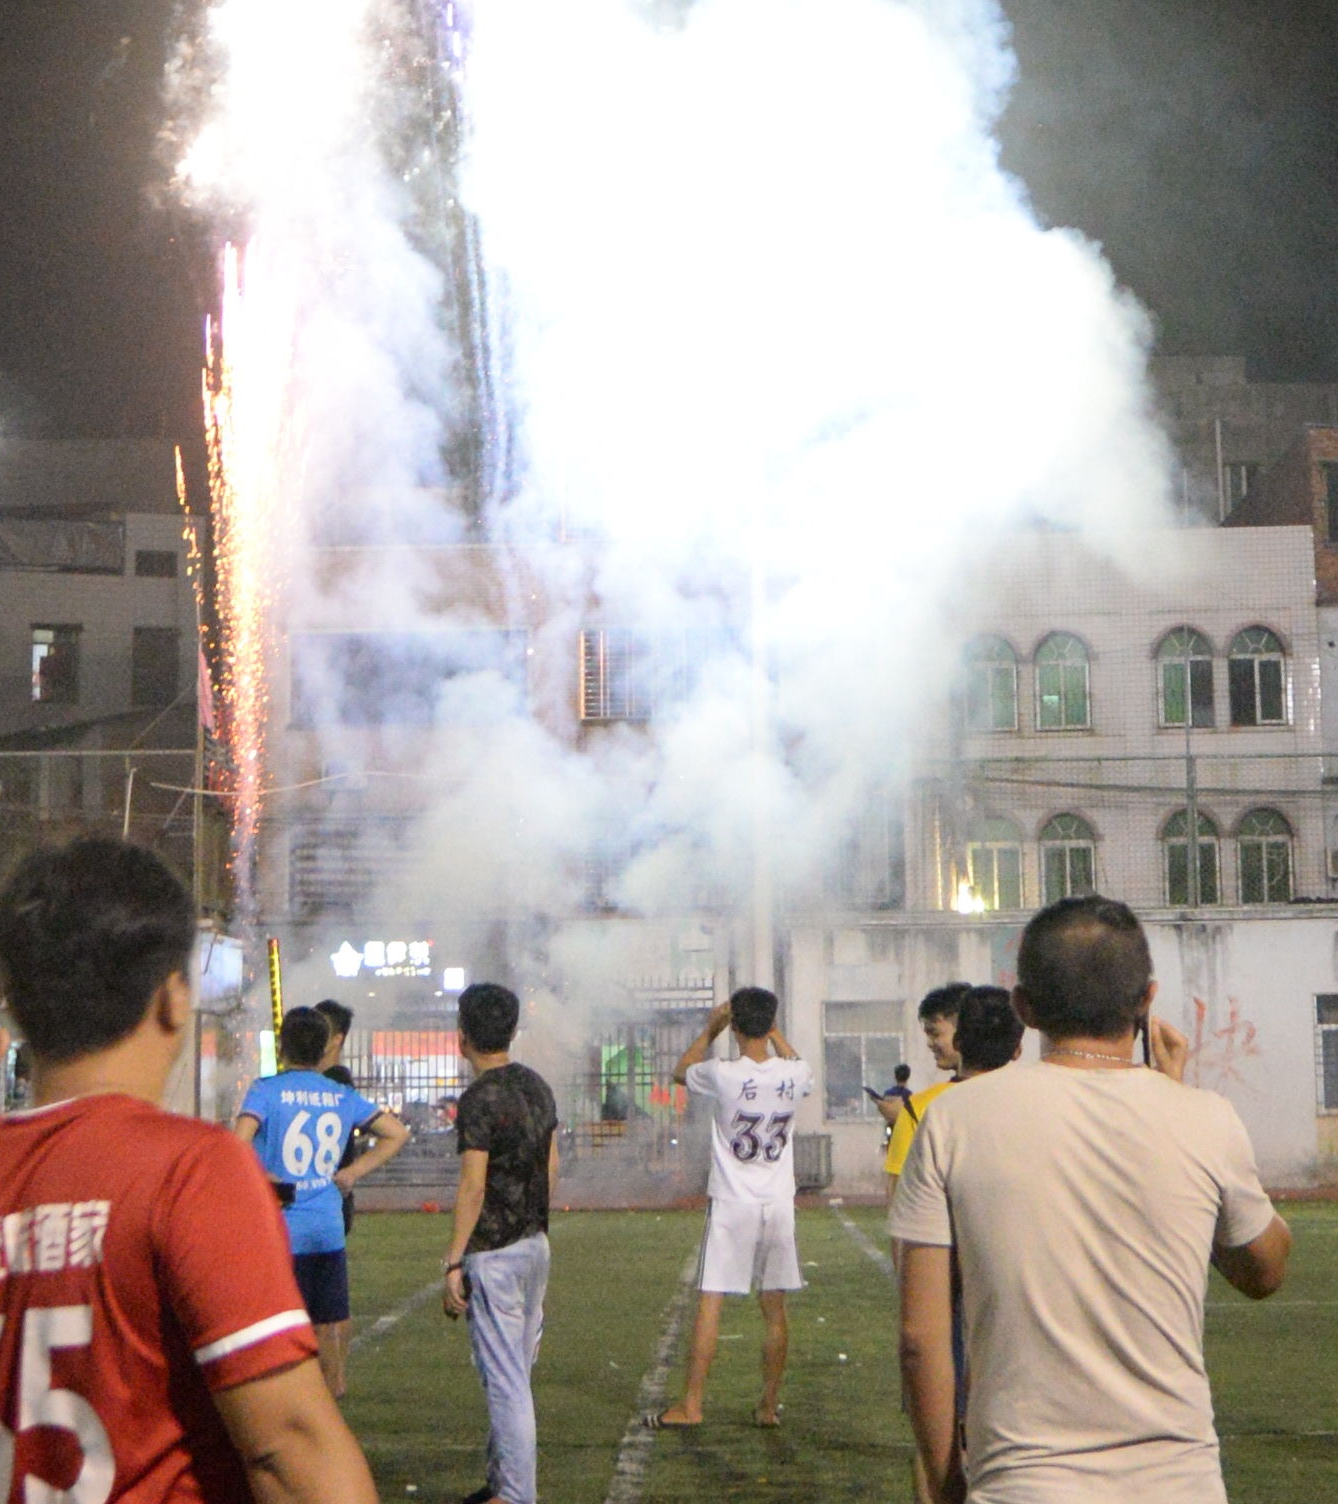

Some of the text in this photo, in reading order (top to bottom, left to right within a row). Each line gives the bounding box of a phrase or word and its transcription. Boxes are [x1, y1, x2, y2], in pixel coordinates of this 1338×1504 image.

[737, 1077, 796, 1101] 后村
[282, 1110, 342, 1179] 68
[730, 1109, 795, 1163] 33
